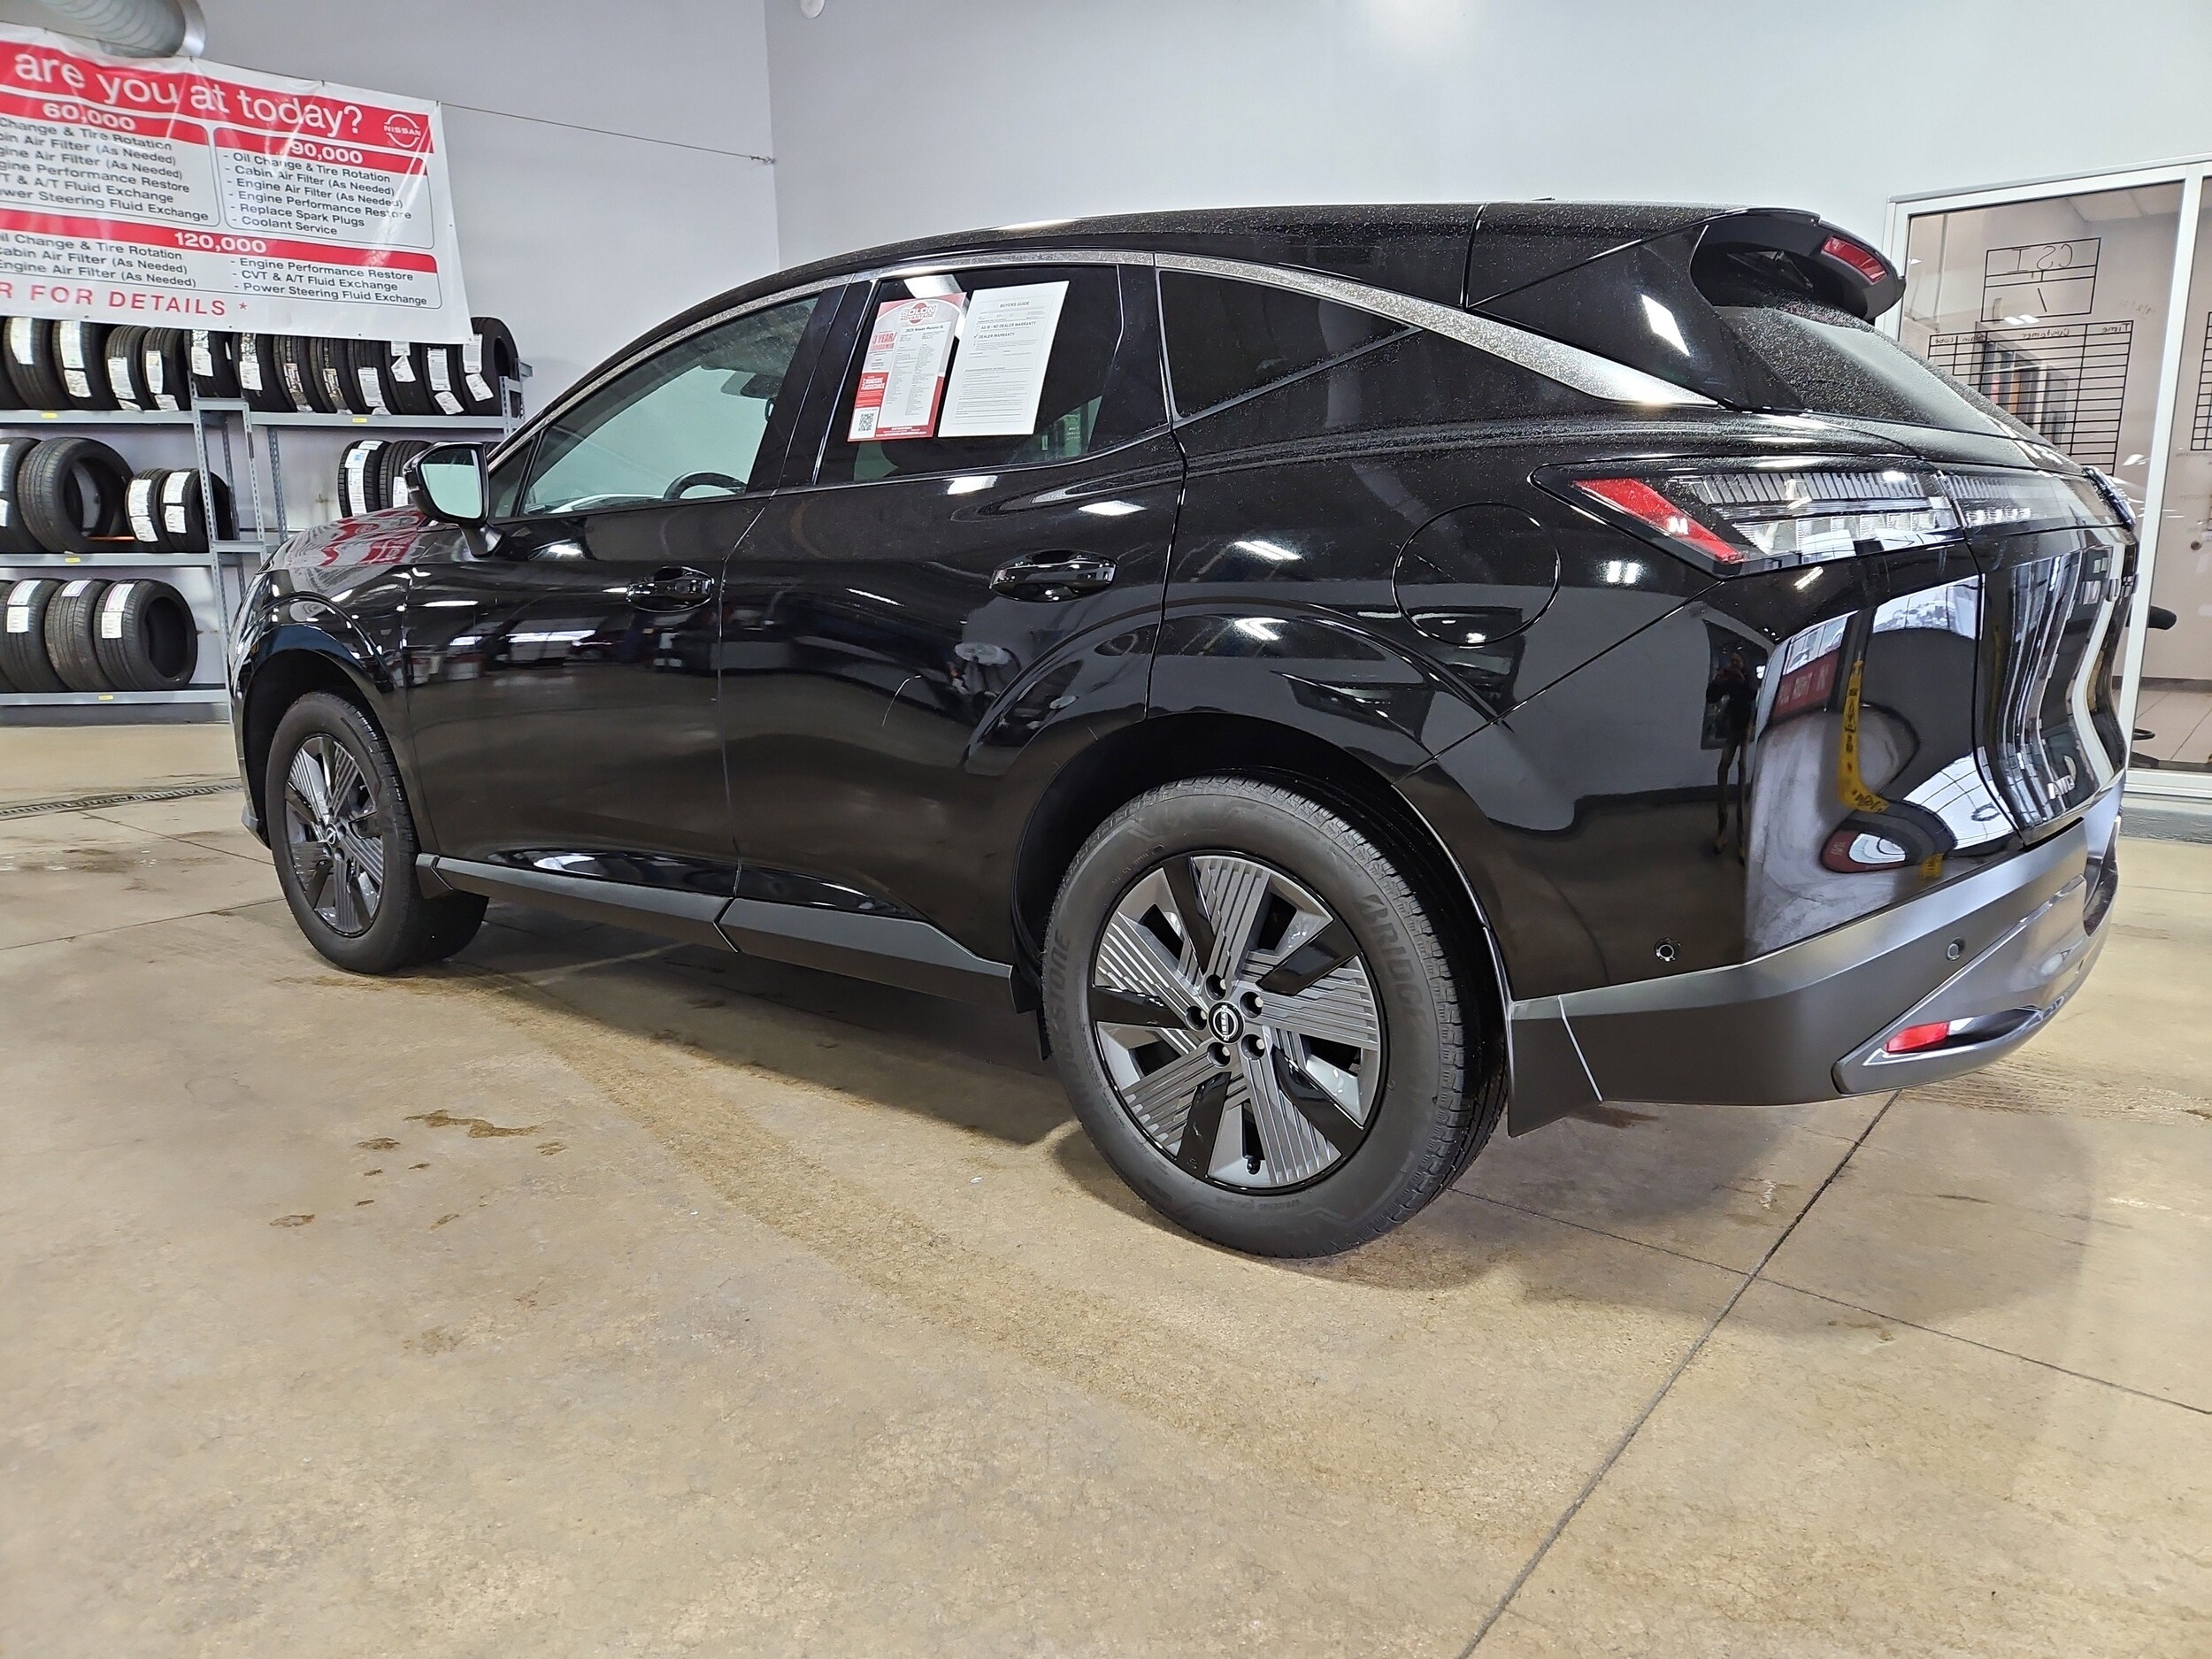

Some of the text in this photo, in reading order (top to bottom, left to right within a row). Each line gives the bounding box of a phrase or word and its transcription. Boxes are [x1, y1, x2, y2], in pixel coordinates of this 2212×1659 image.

[14, 53, 363, 137] are you at today?
[42, 102, 136, 131] 60,000
[63, 127, 75, 136] &
[79, 127, 108, 140] Tire
[111, 134, 172, 150] Rotation
[383, 124, 421, 137] NISSAN
[24, 134, 45, 146] Air
[50, 139, 91, 151] Filter
[96, 144, 119, 155] (As
[122, 148, 176, 166] Needed)
[290, 141, 364, 164] 90,000
[35, 150, 56, 161] Air
[61, 153, 101, 165] Filter
[105, 158, 128, 170] (As
[132, 162, 183, 180] Needed)
[36, 163, 136, 184] Performance
[142, 176, 190, 193] Restore
[233, 152, 250, 163] Oil
[254, 156, 302, 171] Change
[306, 163, 314, 172] &
[316, 165, 338, 176] Tire
[342, 168, 390, 182] Rotation
[17, 175, 28, 185] &
[34, 177, 59, 188] A/T
[64, 180, 101, 193] Fluid
[106, 184, 173, 204] Exchange
[234, 165, 273, 178] Cabin
[278, 172, 293, 180] Air
[296, 173, 325, 185] Filter
[328, 180, 347, 188] (As
[349, 182, 395, 196] Needed)
[236, 178, 280, 191] Engine
[284, 184, 301, 194] Air
[304, 187, 332, 198] Filter
[336, 192, 355, 202] (As
[357, 194, 403, 209] Needed)
[0, 188, 209, 221] wer Steering Fluid Exchange
[238, 190, 282, 204] Engine
[287, 196, 362, 214] Performance
[240, 204, 293, 217] Replace
[296, 209, 329, 222] Spark
[332, 214, 365, 227] Plugs
[242, 216, 293, 229] Coolant
[295, 221, 338, 235] Service
[14, 234, 74, 250] Change
[80, 241, 91, 250] &
[96, 242, 124, 254] Tire
[128, 245, 182, 260] Rotation
[174, 232, 266, 253] 120,000
[0, 247, 188, 274] abin Air Filter (As Needed)
[239, 257, 284, 270] Engine
[288, 261, 365, 277] Performance
[367, 269, 414, 281] Restore
[52, 265, 73, 274] Air
[78, 266, 116, 279] Filter
[120, 272, 142, 281] (As
[146, 273, 196, 288] Needed)
[242, 270, 268, 280] CVT
[273, 273, 282, 281] &
[285, 273, 303, 283] A/T
[307, 275, 335, 287] Fluid
[339, 279, 398, 292] Exchange
[29, 284, 93, 306] FOR
[108, 290, 226, 316] DETAILS
[243, 282, 285, 294] Power
[288, 286, 339, 300] Steering
[342, 290, 372, 301] Fluid
[375, 292, 427, 306] Exchange
[901, 304, 937, 318] SOLON
